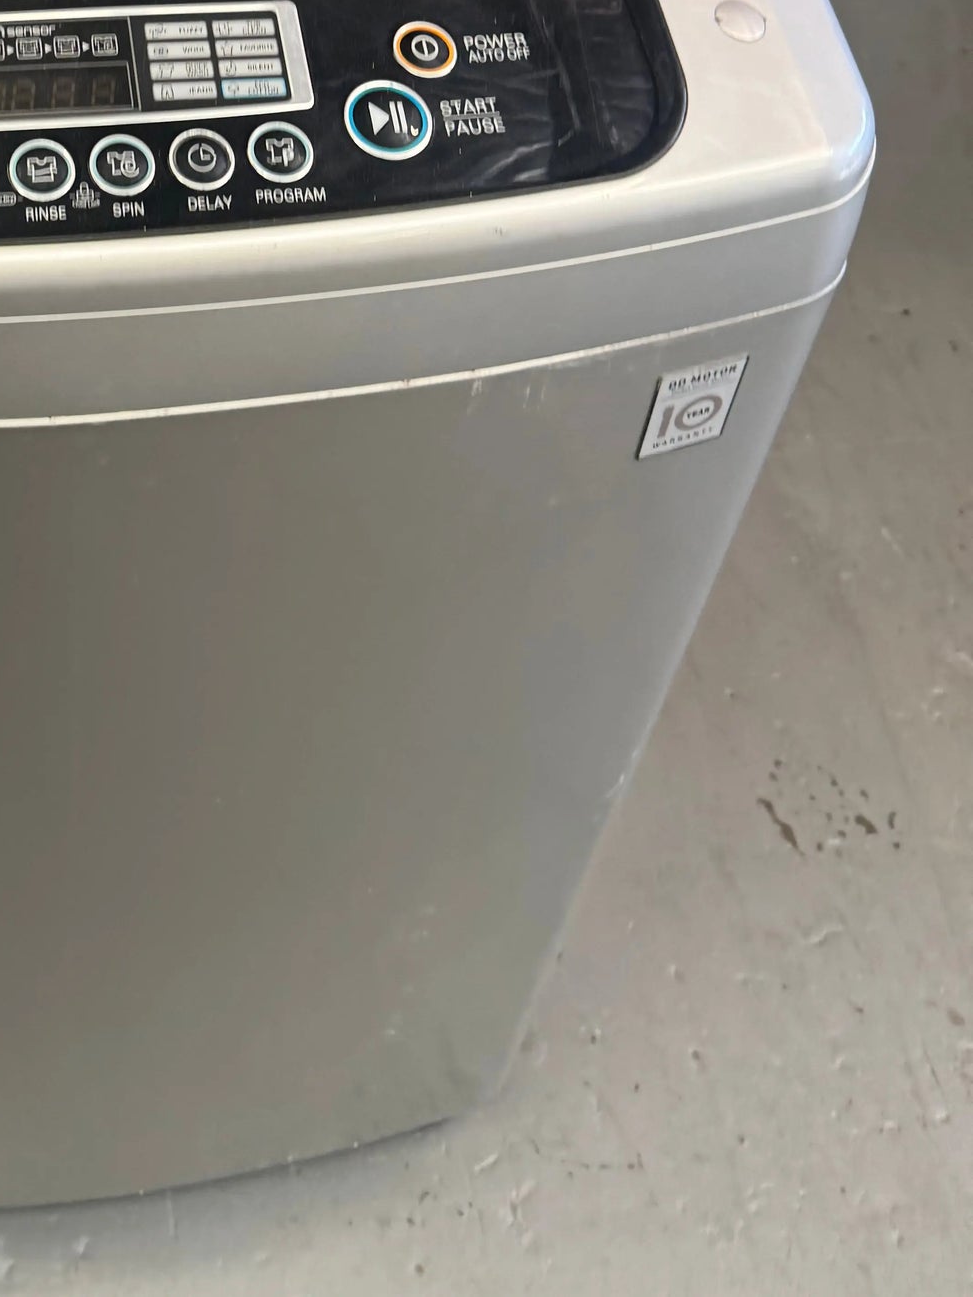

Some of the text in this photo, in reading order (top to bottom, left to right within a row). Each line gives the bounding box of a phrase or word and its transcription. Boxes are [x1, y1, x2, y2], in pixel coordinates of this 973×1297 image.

[463, 32, 528, 52] POWER
[469, 45, 531, 64] AUTO OFF
[439, 96, 497, 117] START
[445, 116, 506, 137] PAUSE
[188, 195, 233, 213] DELAY
[255, 186, 327, 205] PROGRAM
[25, 205, 67, 223] RINSE
[113, 201, 145, 218] SPIN
[657, 394, 724, 439] 10
